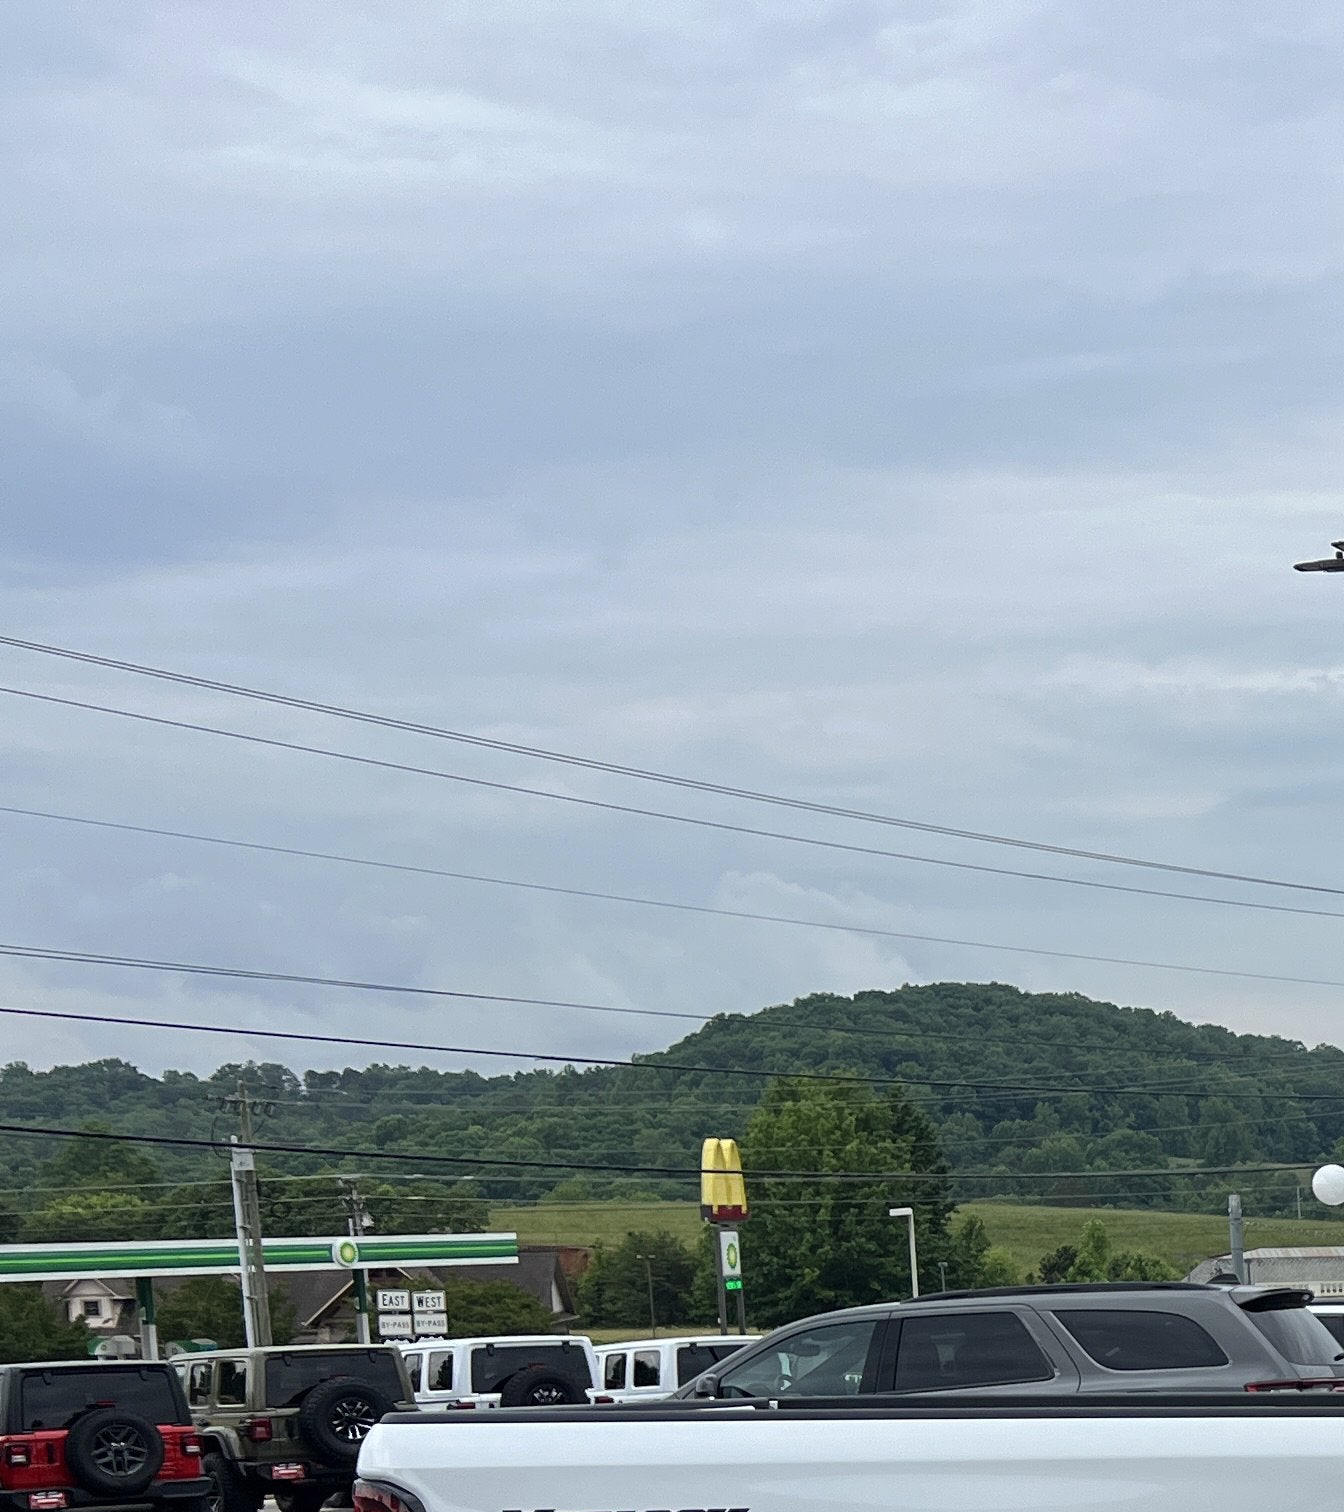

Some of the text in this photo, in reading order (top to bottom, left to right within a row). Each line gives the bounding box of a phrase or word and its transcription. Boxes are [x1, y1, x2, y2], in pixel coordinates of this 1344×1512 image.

[381, 1293, 405, 1307] EAST
[415, 1295, 442, 1308] WEST
[381, 1321, 410, 1329] BY-PASS
[416, 1319, 445, 1328] BY-PASS
